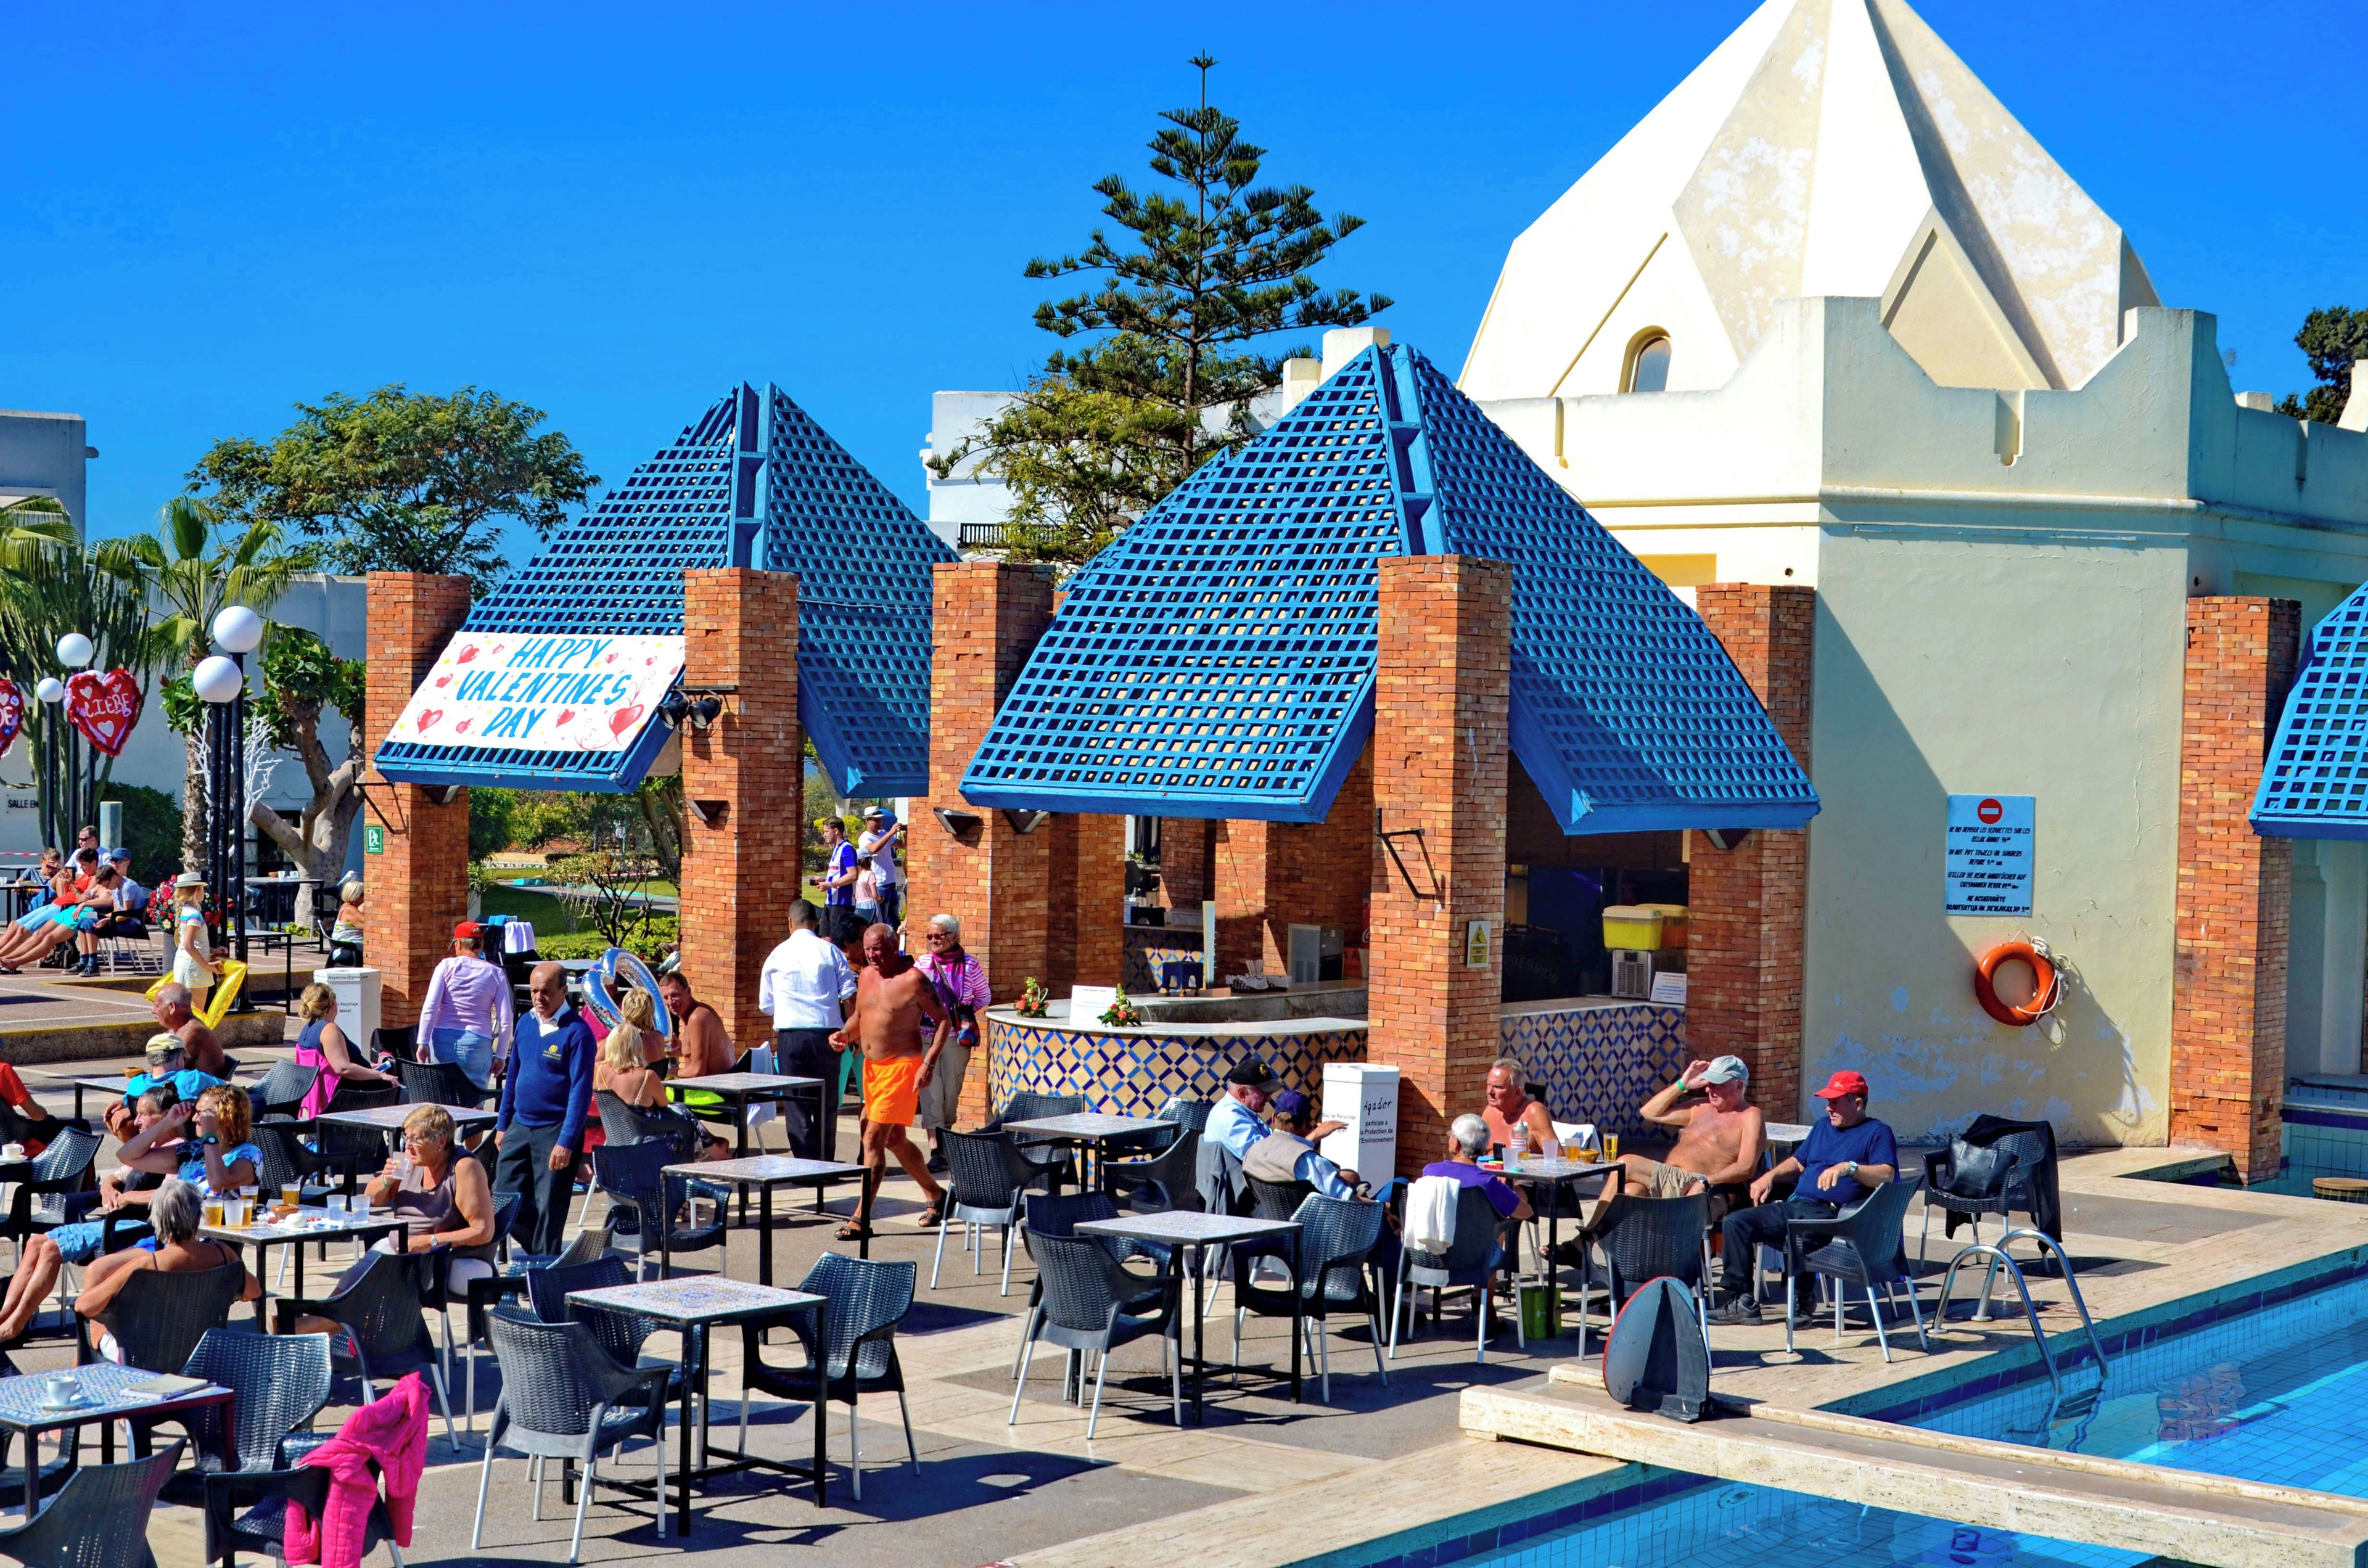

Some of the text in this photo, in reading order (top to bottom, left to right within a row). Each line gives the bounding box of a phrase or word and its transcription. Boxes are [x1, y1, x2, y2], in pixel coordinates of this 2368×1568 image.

[506, 638, 612, 668] HAPPY
[84, 692, 130, 718] LIEBE
[481, 707, 547, 739] DAY
[8, 800, 28, 808] SALLE
[1363, 1097, 1392, 1115] Agador
